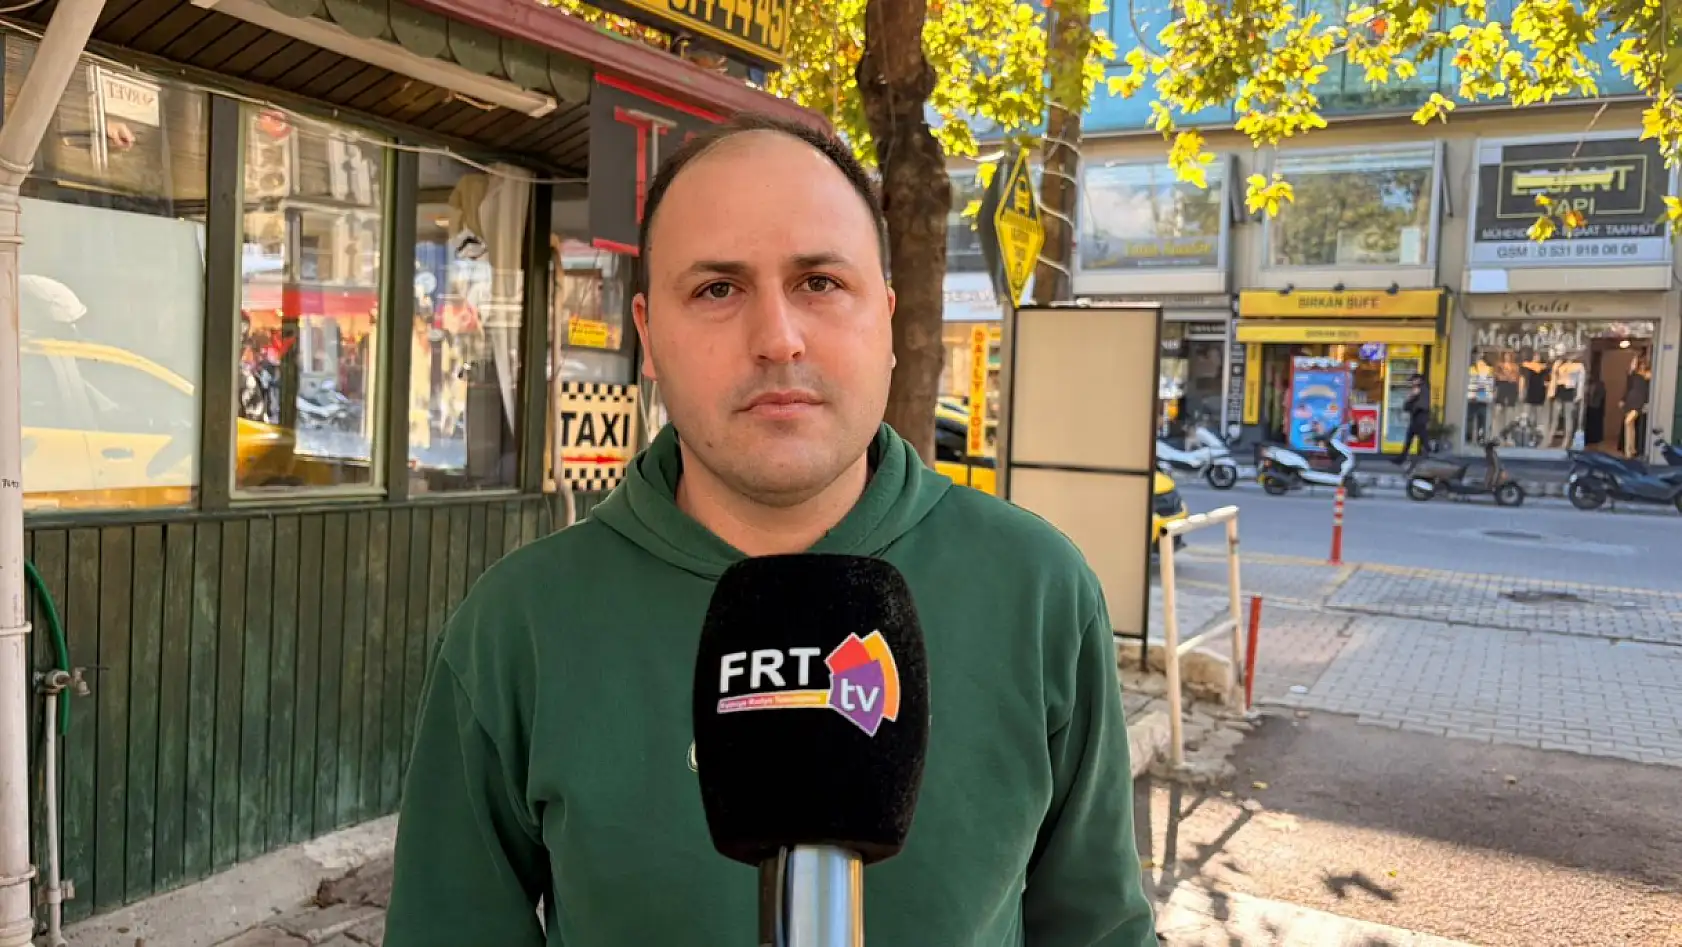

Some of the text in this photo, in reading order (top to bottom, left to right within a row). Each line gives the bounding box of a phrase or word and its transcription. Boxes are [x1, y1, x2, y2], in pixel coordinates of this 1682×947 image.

[1497, 245, 1528, 259] GSM
[561, 411, 630, 447] TAXI
[719, 647, 880, 712] FRT tv
